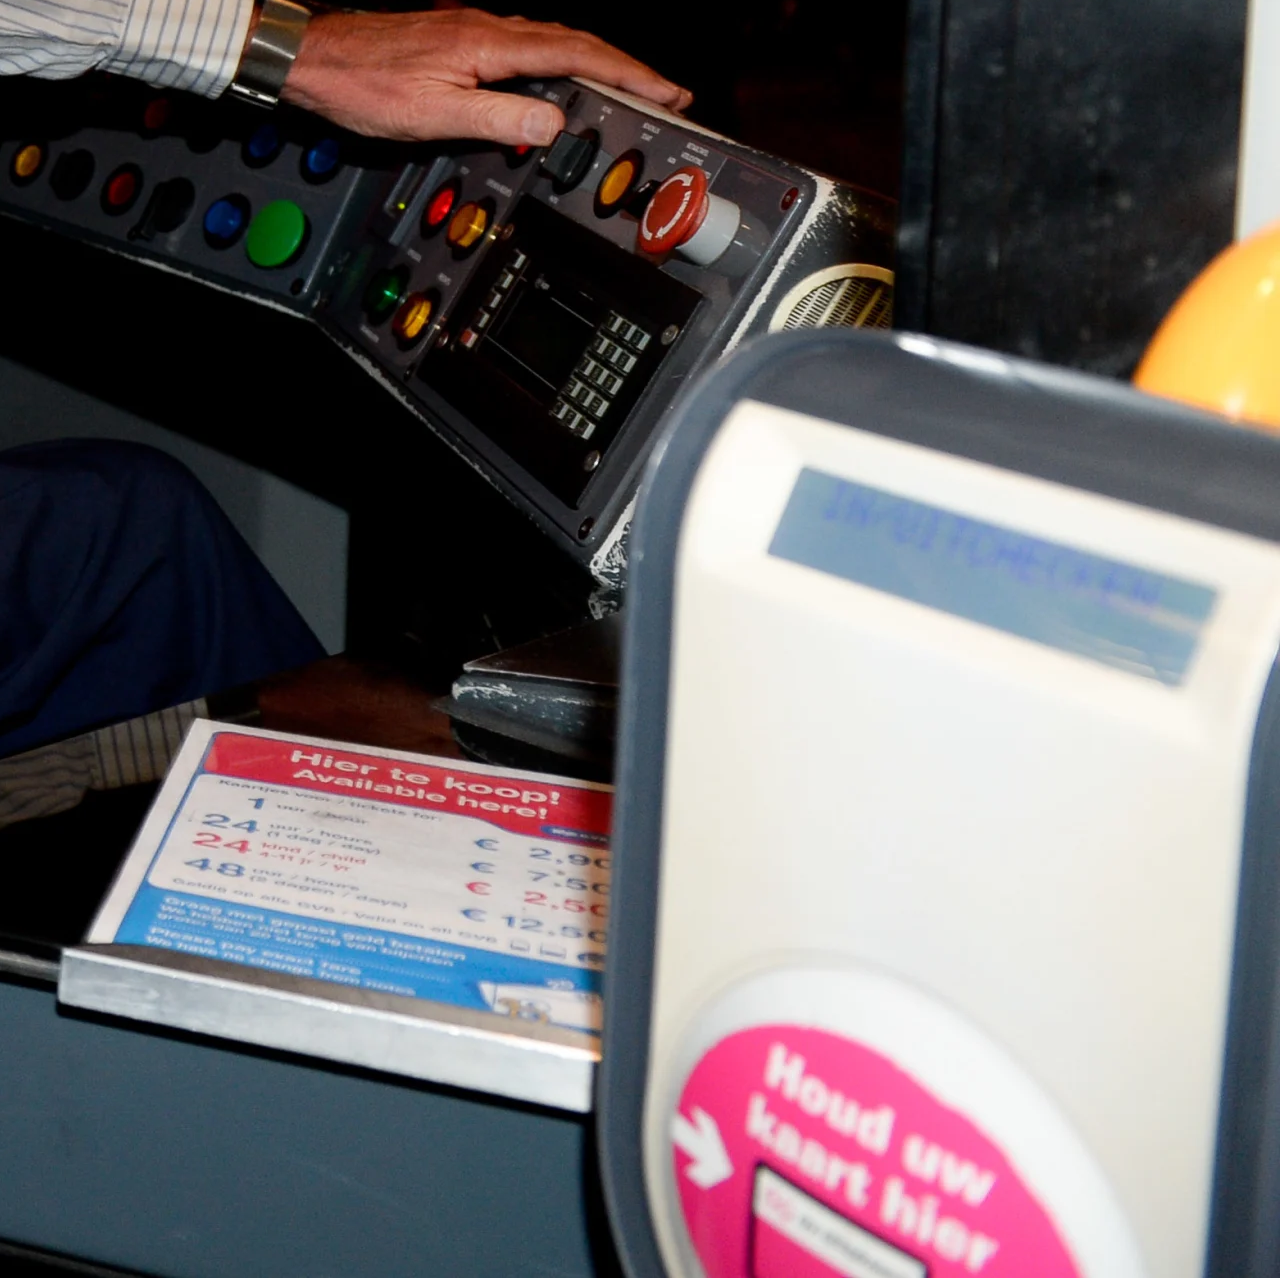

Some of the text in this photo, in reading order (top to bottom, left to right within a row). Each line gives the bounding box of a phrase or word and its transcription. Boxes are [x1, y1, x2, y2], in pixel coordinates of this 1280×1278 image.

[218, 778, 290, 797] Kaartjes
[290, 749, 561, 807] Hier te koop!
[292, 768, 549, 820] Available here!
[247, 797, 266, 810] 1
[201, 813, 261, 834] 24
[320, 829, 374, 846] hours
[473, 838, 500, 852] €
[192, 832, 253, 854] 24
[260, 841, 302, 855] kind
[320, 851, 368, 866] child
[183, 857, 246, 879] 48
[469, 861, 496, 874] €
[274, 878, 336, 897] dagen
[356, 893, 409, 911] days)
[465, 880, 492, 896] €
[163, 895, 467, 962] Graag met gepast geld betalen
[460, 907, 487, 923] €
[144, 934, 173, 948] We
[148, 926, 362, 975] Please pay exact fare
[763, 1040, 998, 1207] Houd uw
[744, 1091, 872, 1210] kaart
[879, 1175, 1000, 1274] hier
